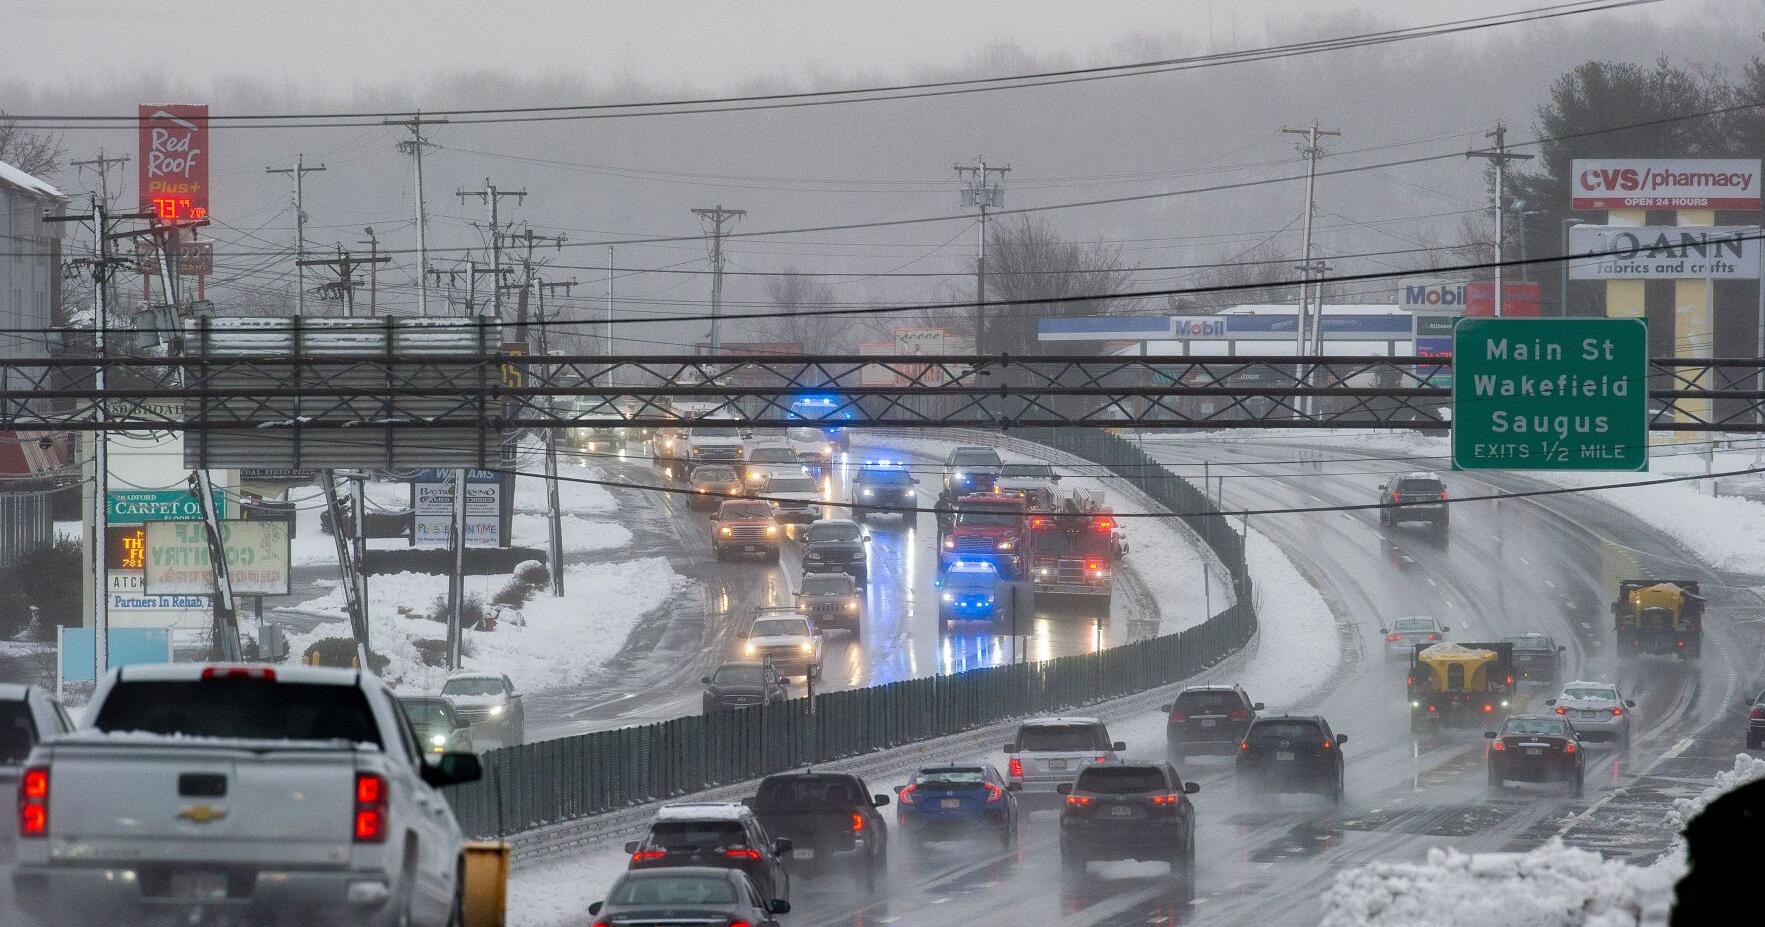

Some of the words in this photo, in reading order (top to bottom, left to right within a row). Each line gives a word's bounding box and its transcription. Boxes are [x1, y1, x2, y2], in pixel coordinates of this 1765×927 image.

[152, 127, 191, 152] Red
[148, 149, 200, 178] Roof
[149, 180, 200, 193] Plus+
[1580, 168, 1752, 191] CVS/pharmacy
[1598, 261, 1649, 273] fabrics
[1655, 261, 1684, 273] and
[1405, 285, 1467, 305] Mobil
[1175, 320, 1224, 335] Mobil
[1486, 338, 1562, 360] Main
[1581, 338, 1614, 361] St
[1473, 374, 1628, 397] Wakefield
[1491, 410, 1609, 440] Saugus
[1474, 444, 1529, 457] EXITS
[1580, 444, 1625, 458] MILE
[115, 502, 180, 515] CARPET
[122, 538, 144, 549] TH
[122, 559, 143, 567] 781
[114, 595, 157, 608] Partners
[159, 595, 169, 608] In
[172, 595, 205, 609] Rehab,
